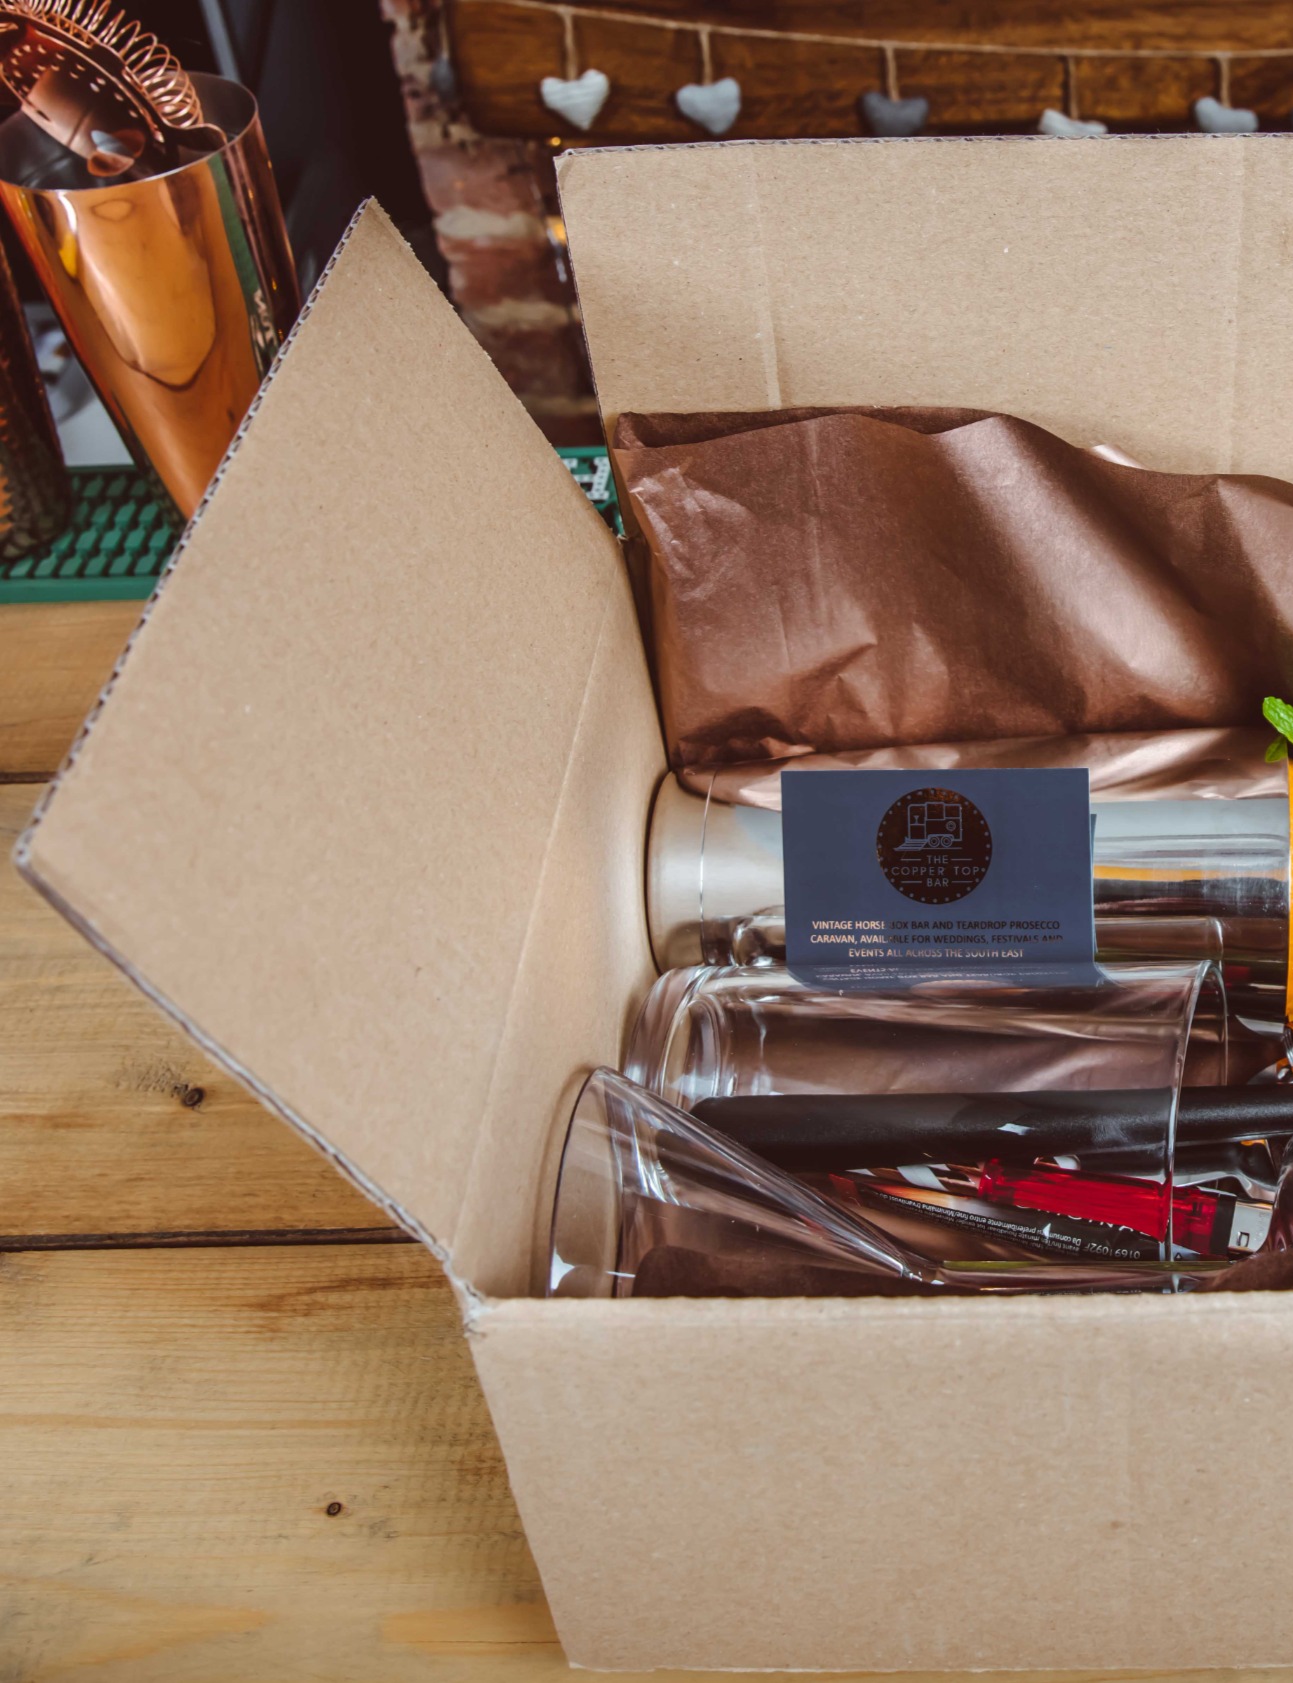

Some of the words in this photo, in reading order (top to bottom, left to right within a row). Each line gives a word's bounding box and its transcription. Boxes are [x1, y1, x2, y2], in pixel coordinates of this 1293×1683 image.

[926, 855, 949, 864] THE
[891, 866, 945, 876] COPPER
[953, 866, 980, 876] TOP
[926, 878, 949, 887] BAR
[812, 920, 853, 930] VINTAGE
[911, 921, 930, 930] BAR
[932, 921, 954, 930] AND
[956, 921, 1007, 930] TEARDROP
[1010, 921, 1061, 930] PROSECCO
[810, 934, 858, 945] CARAVAN,
[912, 935, 931, 944] FOR
[933, 935, 989, 945] WEDDINGS,
[991, 935, 1040, 944] FESTIVALS
[848, 948, 885, 958] EVENTS
[887, 948, 904, 958] ALL
[905, 948, 943, 958] ACROSS
[945, 948, 963, 958] THE
[965, 948, 999, 958] SOUTH
[1001, 948, 1023, 958] EAST
[1037, 1229, 1072, 1242] consumsi
[1072, 1237, 1082, 1247] Da
